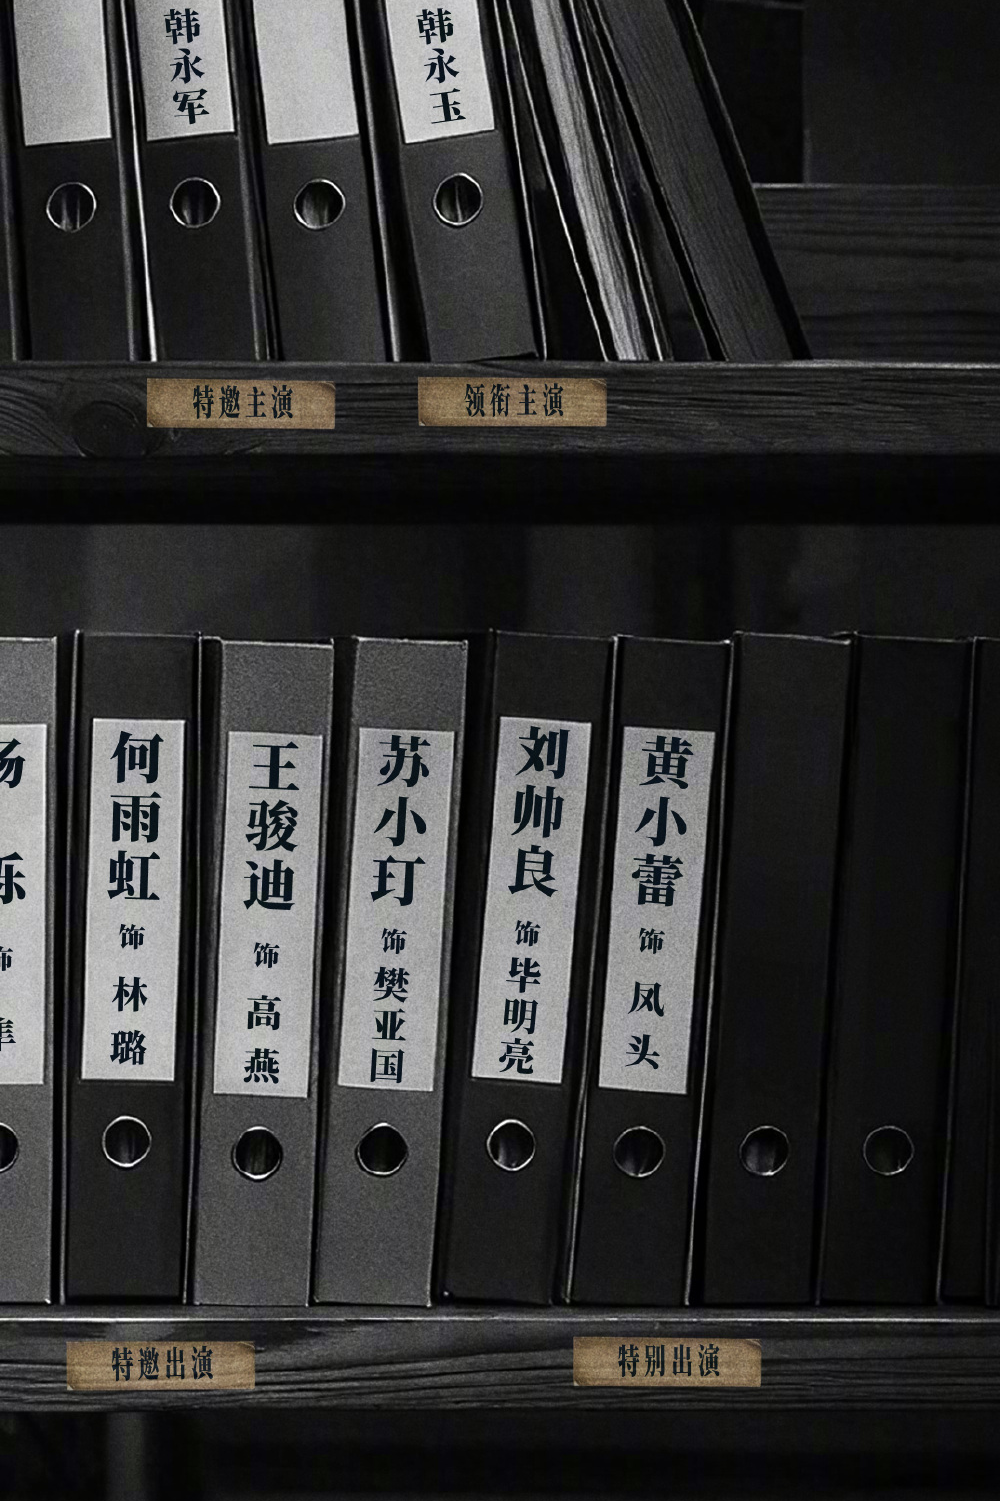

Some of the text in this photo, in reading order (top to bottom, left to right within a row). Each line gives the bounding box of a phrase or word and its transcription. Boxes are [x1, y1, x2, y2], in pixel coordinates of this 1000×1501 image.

[164, 9, 209, 124] 韩永军
[417, 8, 466, 124] 韩永玉
[192, 383, 295, 420] 特邀主演
[464, 381, 565, 418] 领衔主演
[108, 731, 163, 1065] 何雨虹 饰 林璐
[244, 742, 299, 1084] 王骏迪 饰 高燕
[371, 735, 430, 1083] 苏小玎 饰 樊亚国
[495, 726, 570, 1078] 刘帅良 饰 毕明亮
[626, 735, 693, 1069] 黄小蕾 饰 凤头
[112, 1346, 213, 1381] 特邀出演
[618, 1344, 720, 1378] 特别出演
